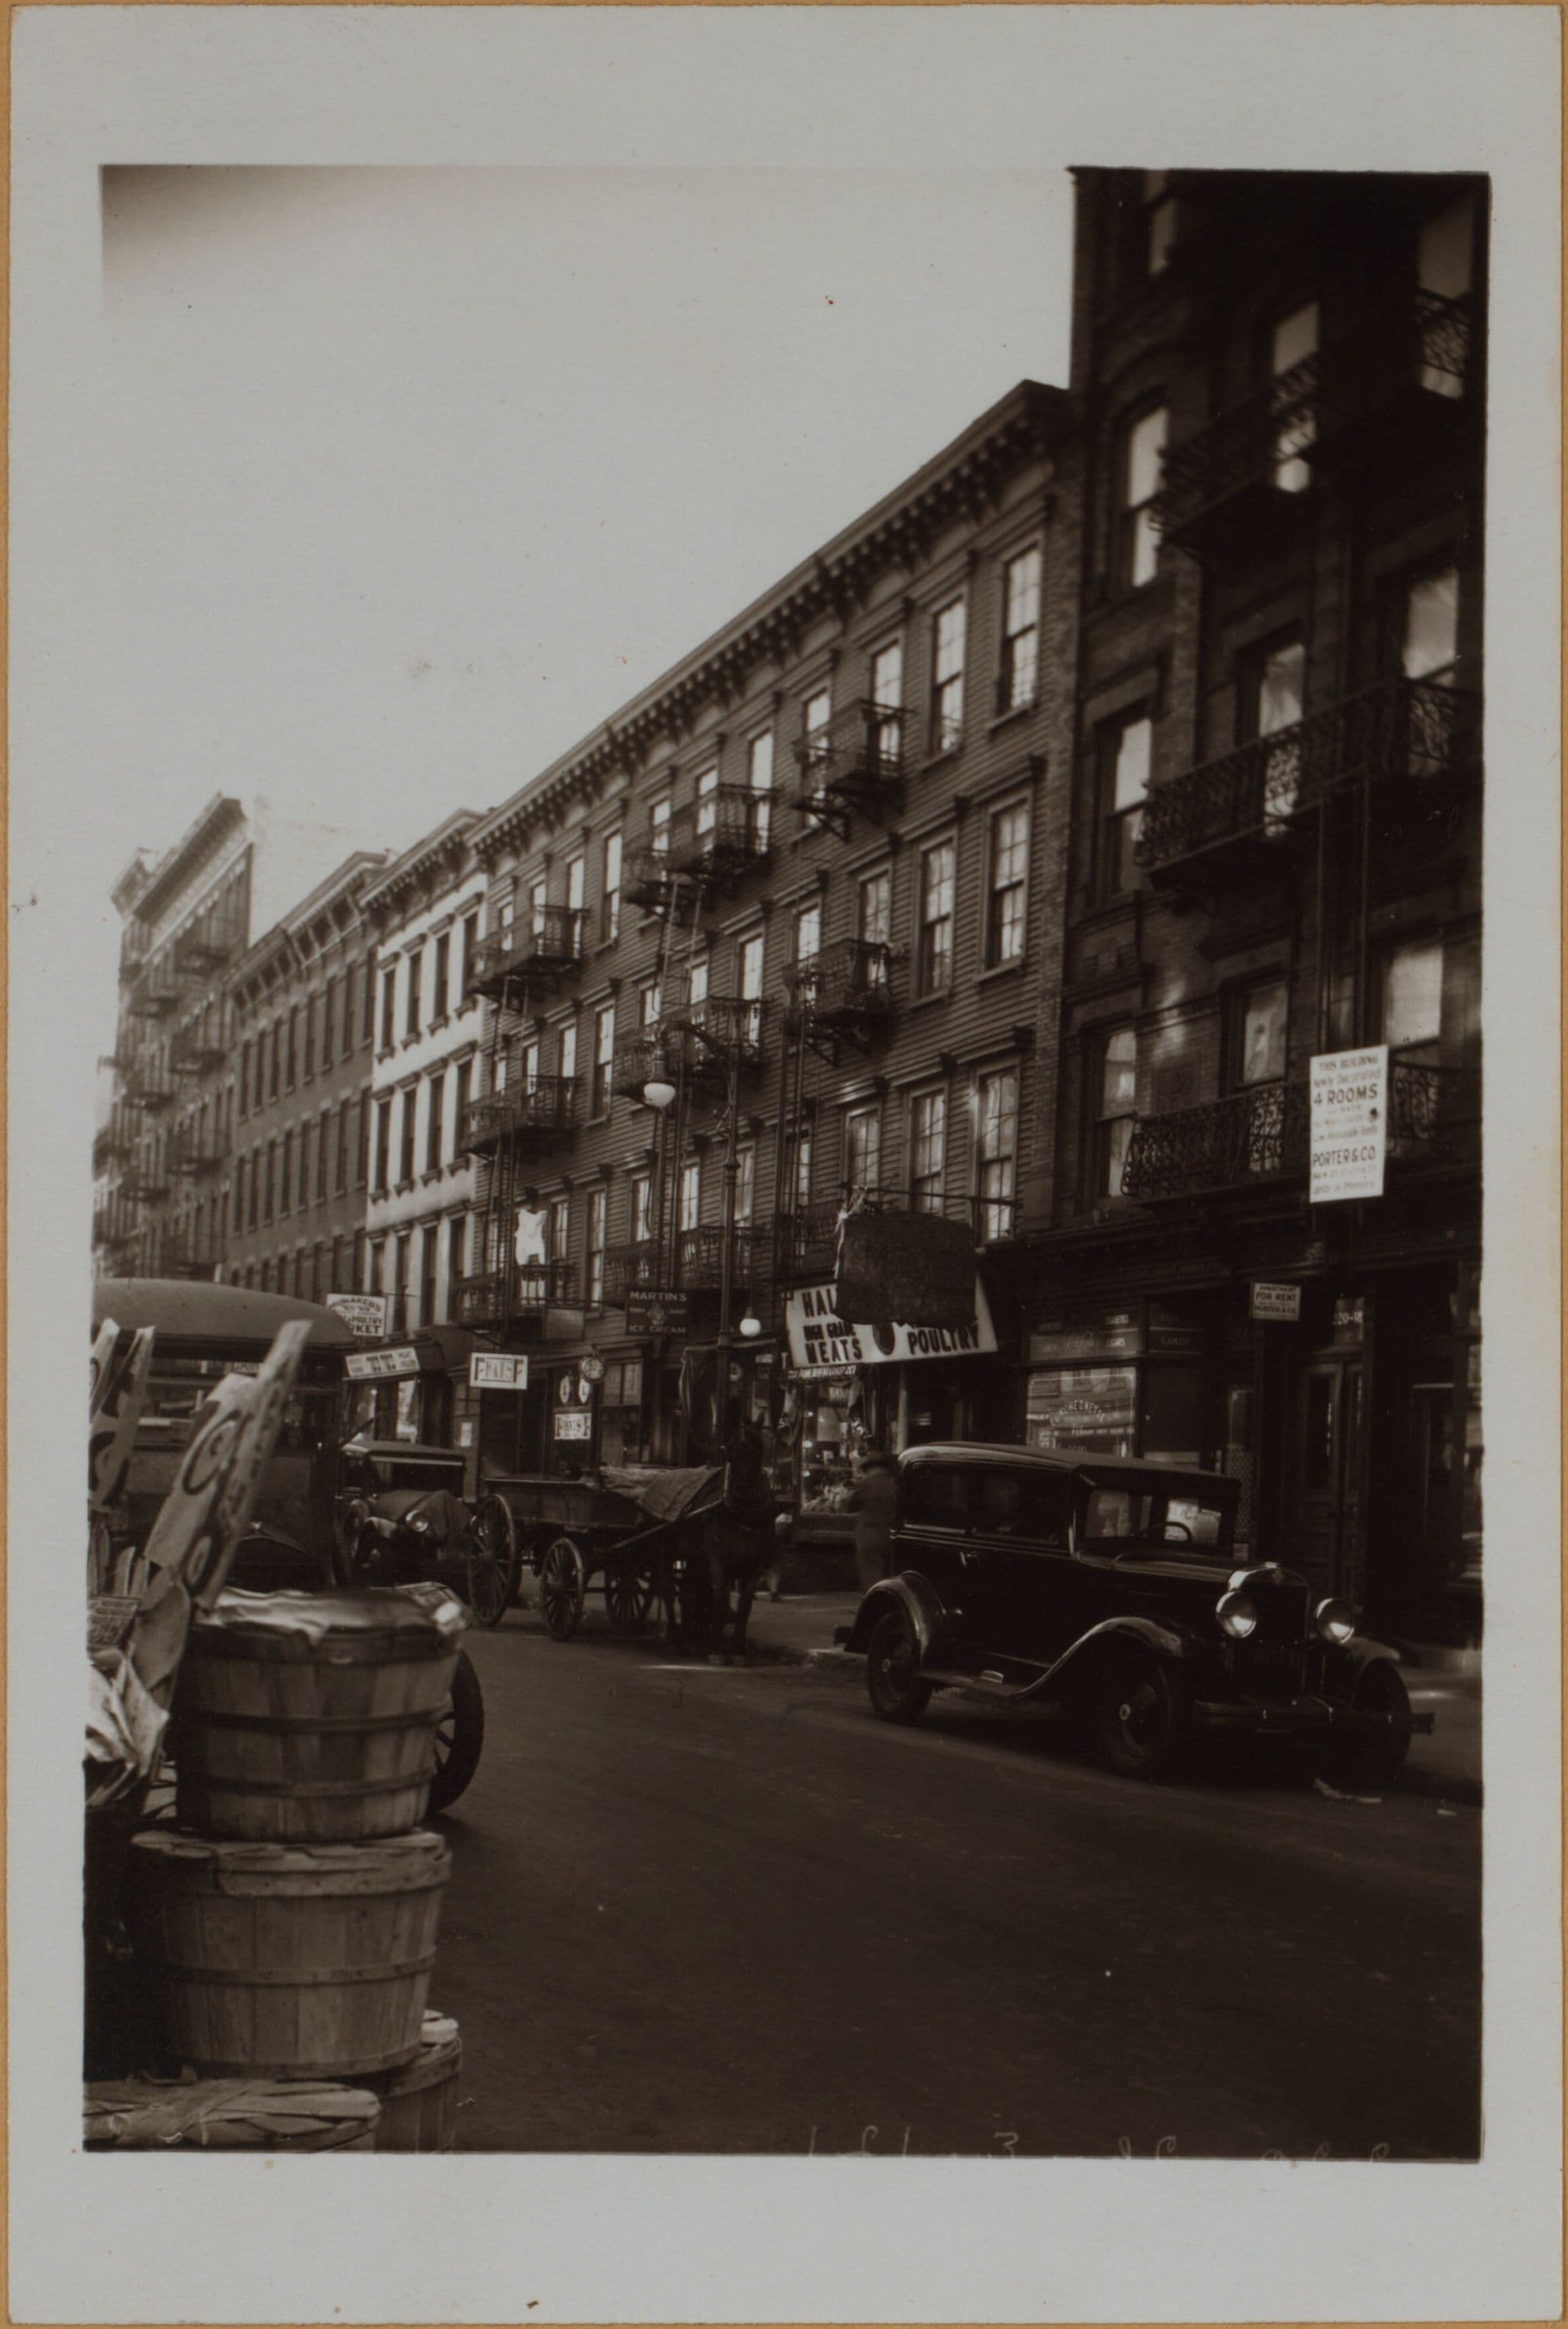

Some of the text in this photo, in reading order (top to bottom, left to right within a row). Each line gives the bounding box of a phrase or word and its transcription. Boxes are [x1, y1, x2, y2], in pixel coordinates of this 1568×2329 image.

[1340, 1055, 1379, 1069] BUILDING
[1314, 1083, 1378, 1105] 4 ROOMS
[1312, 1149, 1350, 1167] PORTER
[1255, 1291, 1296, 1302] FOR RENT
[629, 1324, 687, 1335] ICE CREAM
[907, 1323, 980, 1355] POULTRY
[805, 1337, 864, 1364] MEATS
[1050, 1399, 1106, 1428] LUNCHEONETTE
